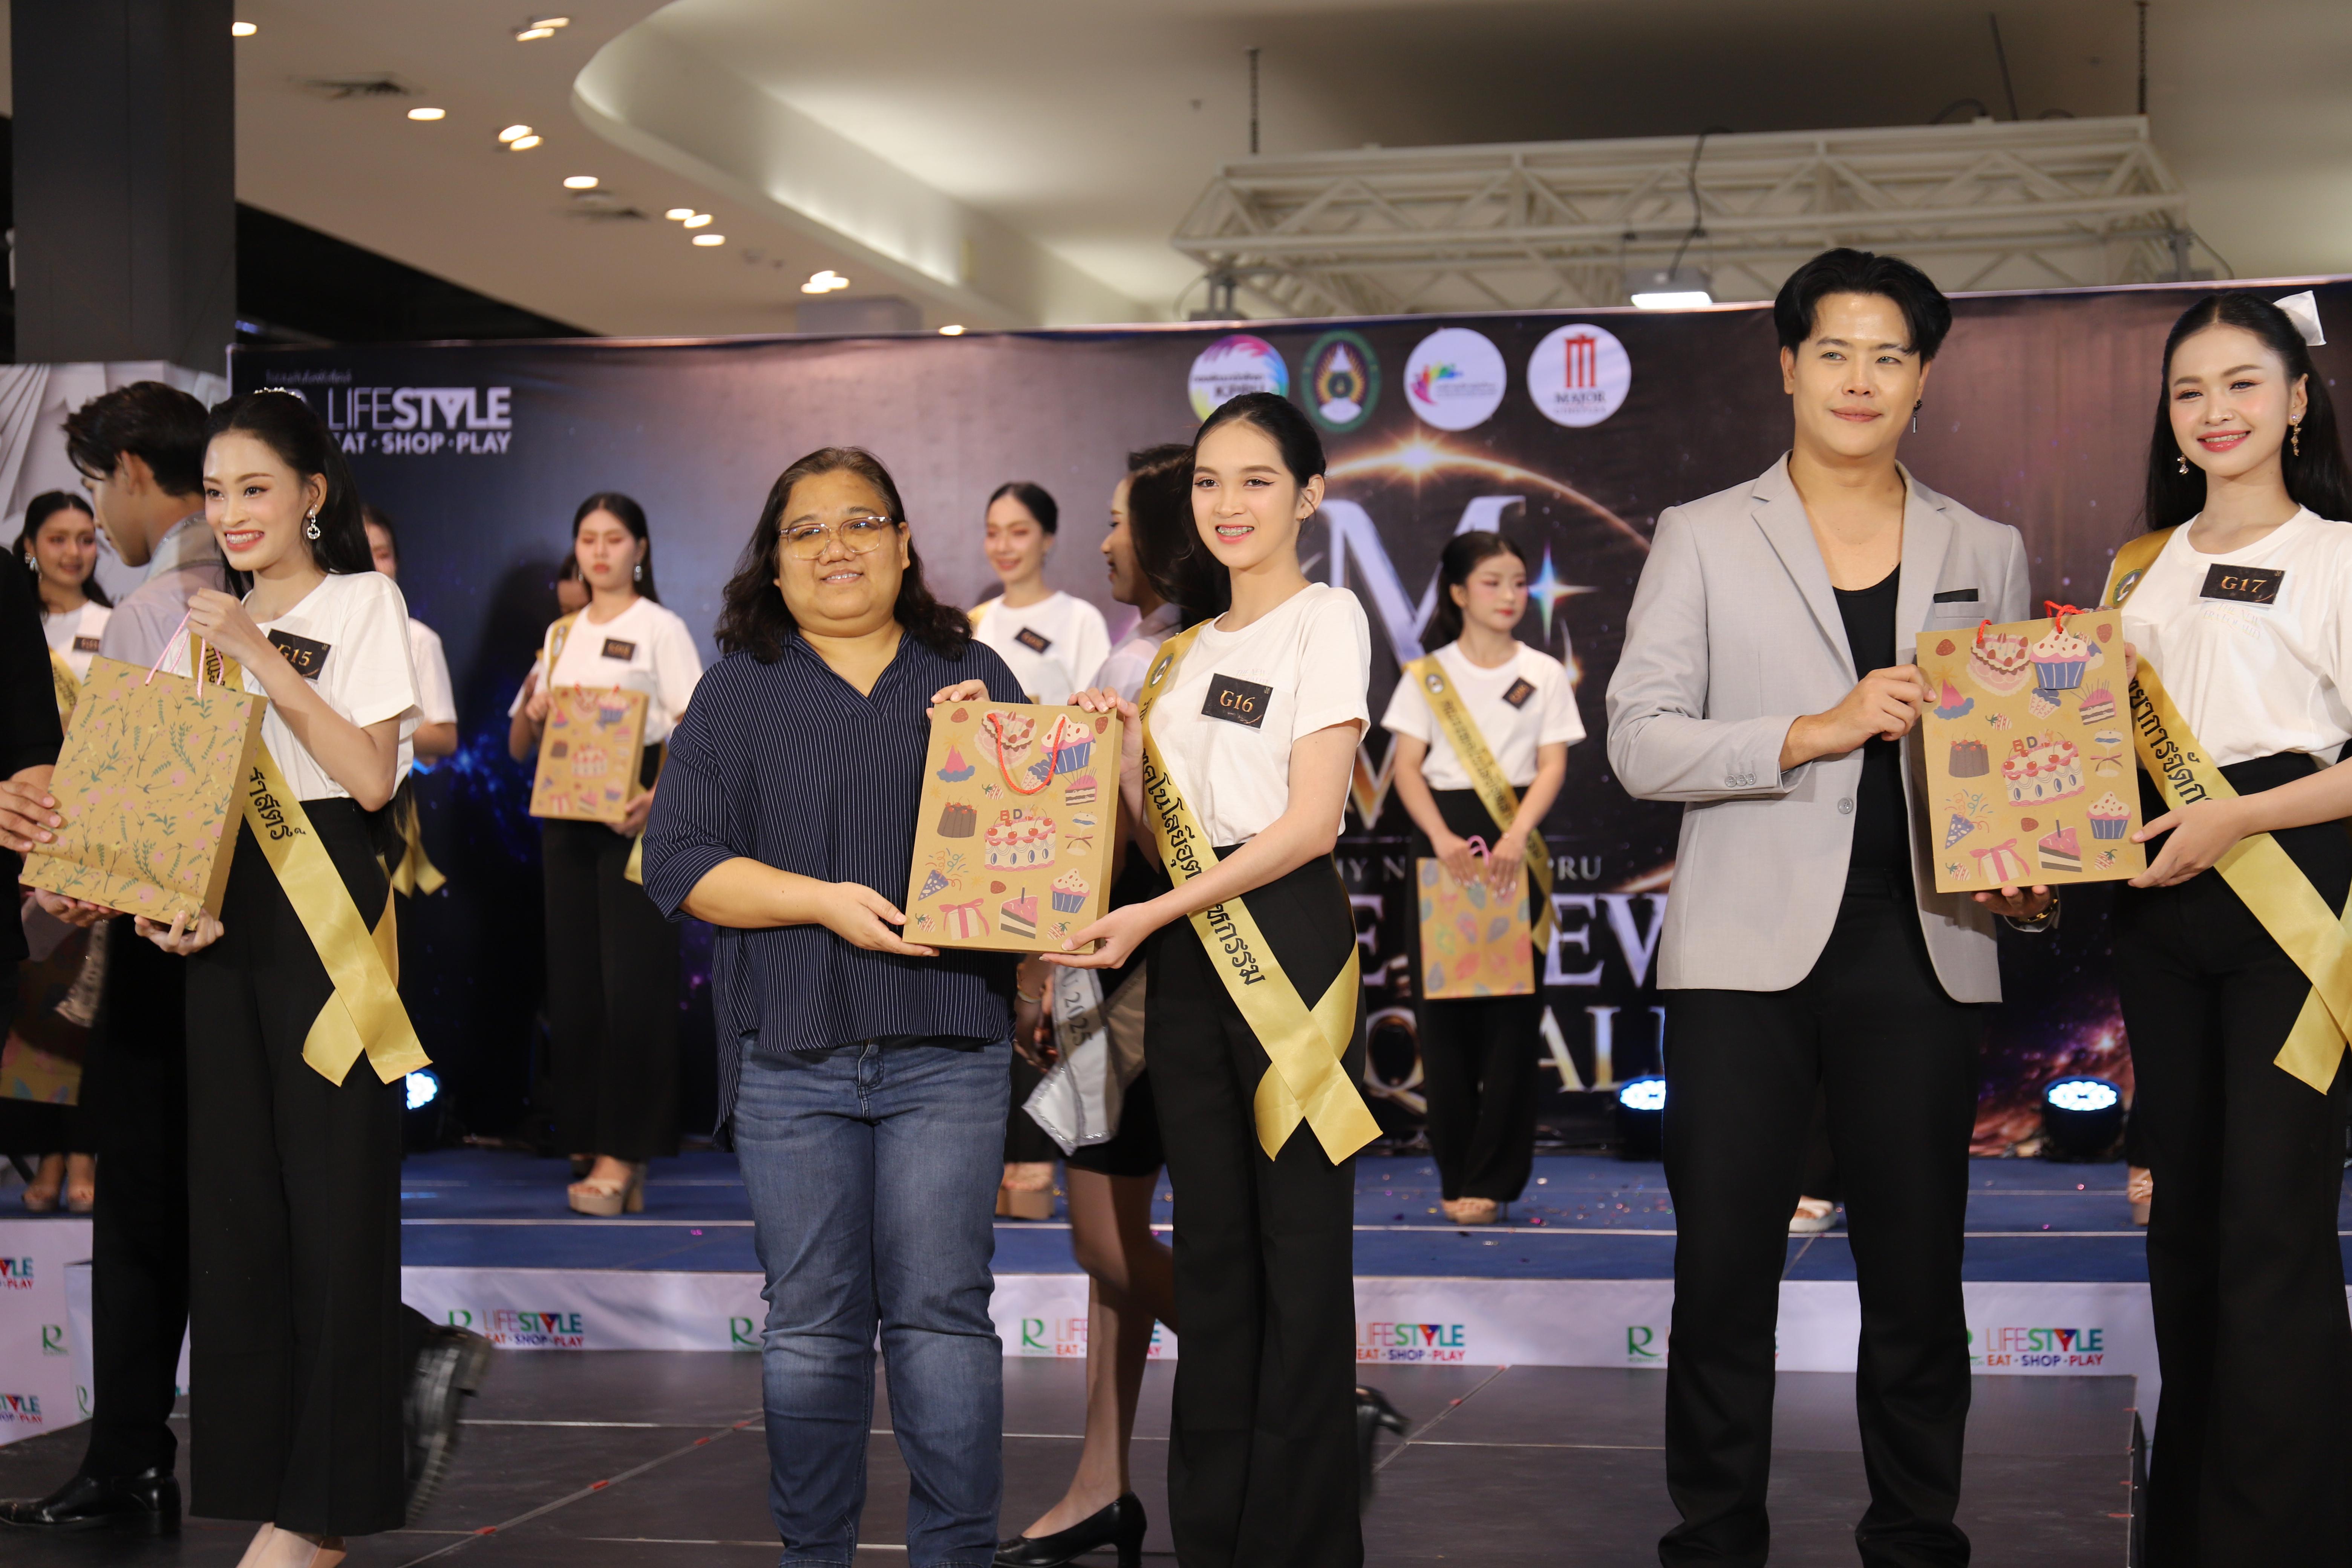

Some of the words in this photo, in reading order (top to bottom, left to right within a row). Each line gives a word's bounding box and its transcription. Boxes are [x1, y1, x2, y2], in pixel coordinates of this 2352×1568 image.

[328, 387, 512, 430] LIFESTYLE
[334, 432, 367, 454] AT
[381, 432, 446, 454] SHOP
[456, 432, 512, 454] PLAY
[2221, 576, 2267, 593] G17
[278, 643, 312, 667] G15
[1220, 690, 1256, 713] G16
[482, 1309, 583, 1334] LIFESTYLE
[553, 1335, 584, 1347] PLAY
[1357, 1322, 1465, 1347] LIFESTYLE
[1986, 1327, 2104, 1352] LIFESTYLE
[1057, 1344, 1079, 1355] EAT
[1357, 1348, 1380, 1360] EAT
[1388, 1349, 1426, 1361] SHOP
[1432, 1349, 1465, 1361] PLAY
[1987, 1354, 2012, 1366] EAT
[2021, 1354, 2062, 1367] SHOP
[2068, 1353, 2104, 1366] PLAY
